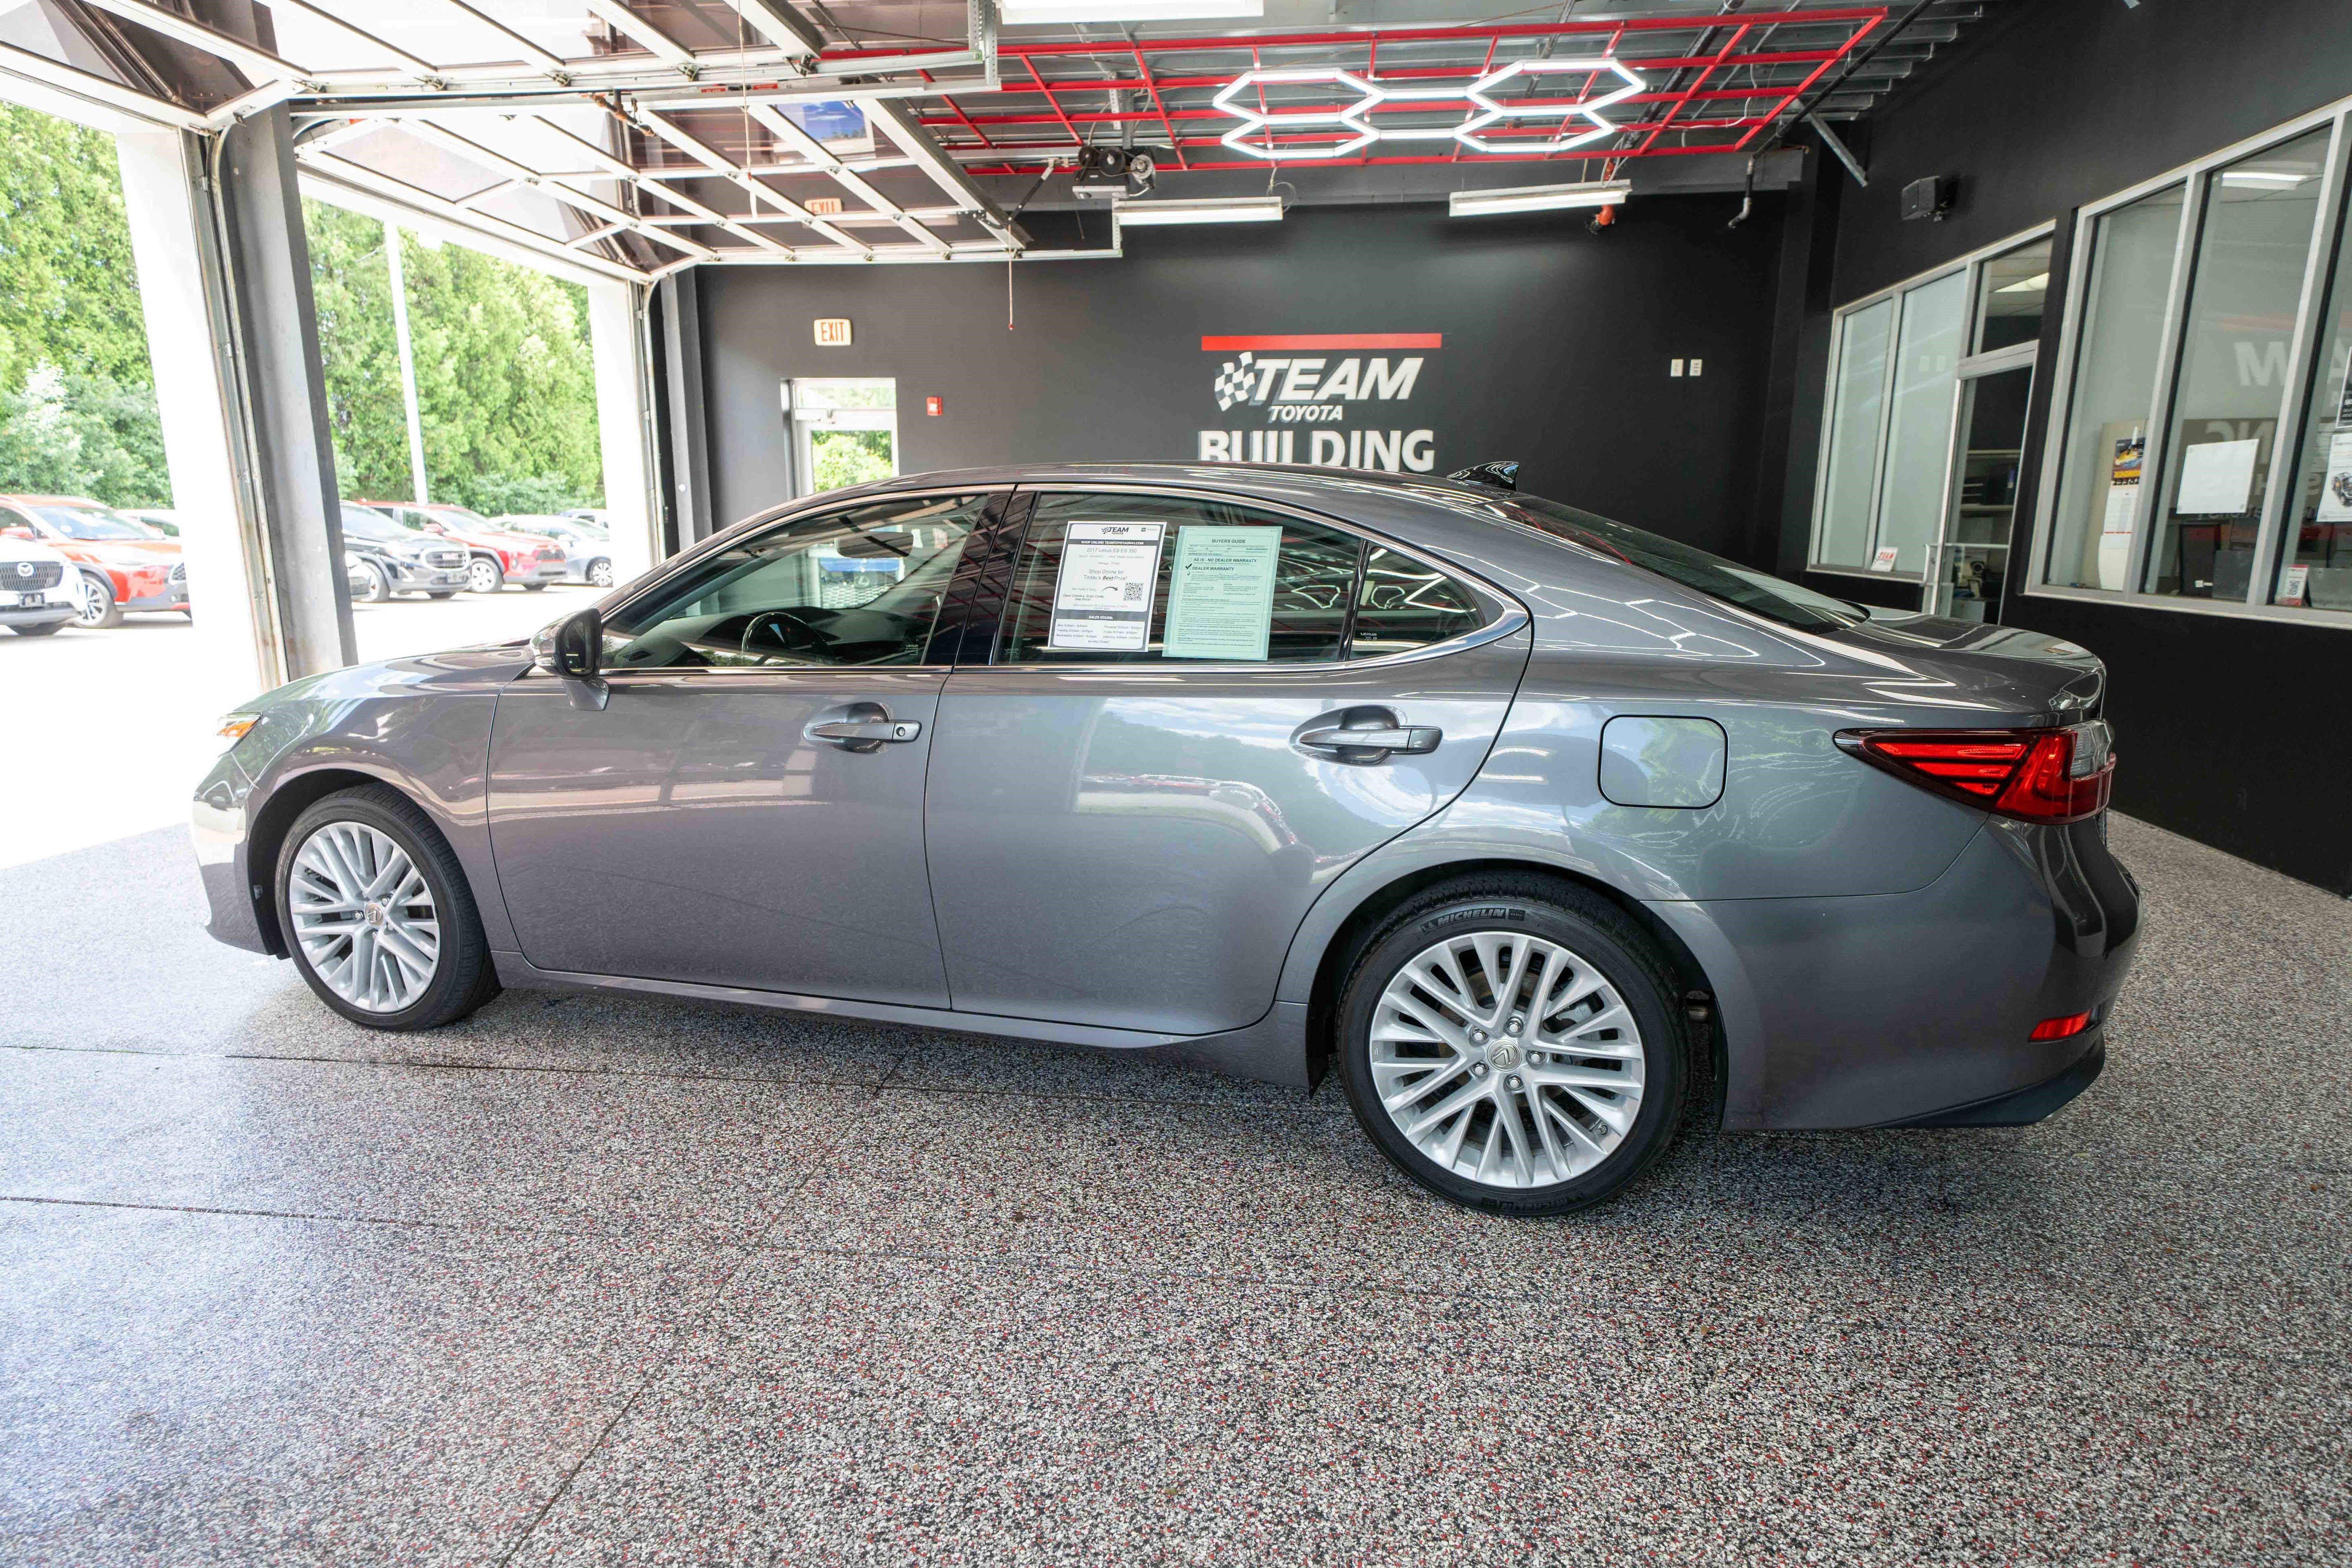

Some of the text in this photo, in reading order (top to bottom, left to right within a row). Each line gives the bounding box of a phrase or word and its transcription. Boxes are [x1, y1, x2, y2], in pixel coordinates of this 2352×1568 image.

[821, 322, 844, 342] EXIT
[1250, 357, 1424, 403] TEAM
[1269, 405, 1343, 422] TOYOTA
[1437, 908, 1506, 926] MICHELIN
